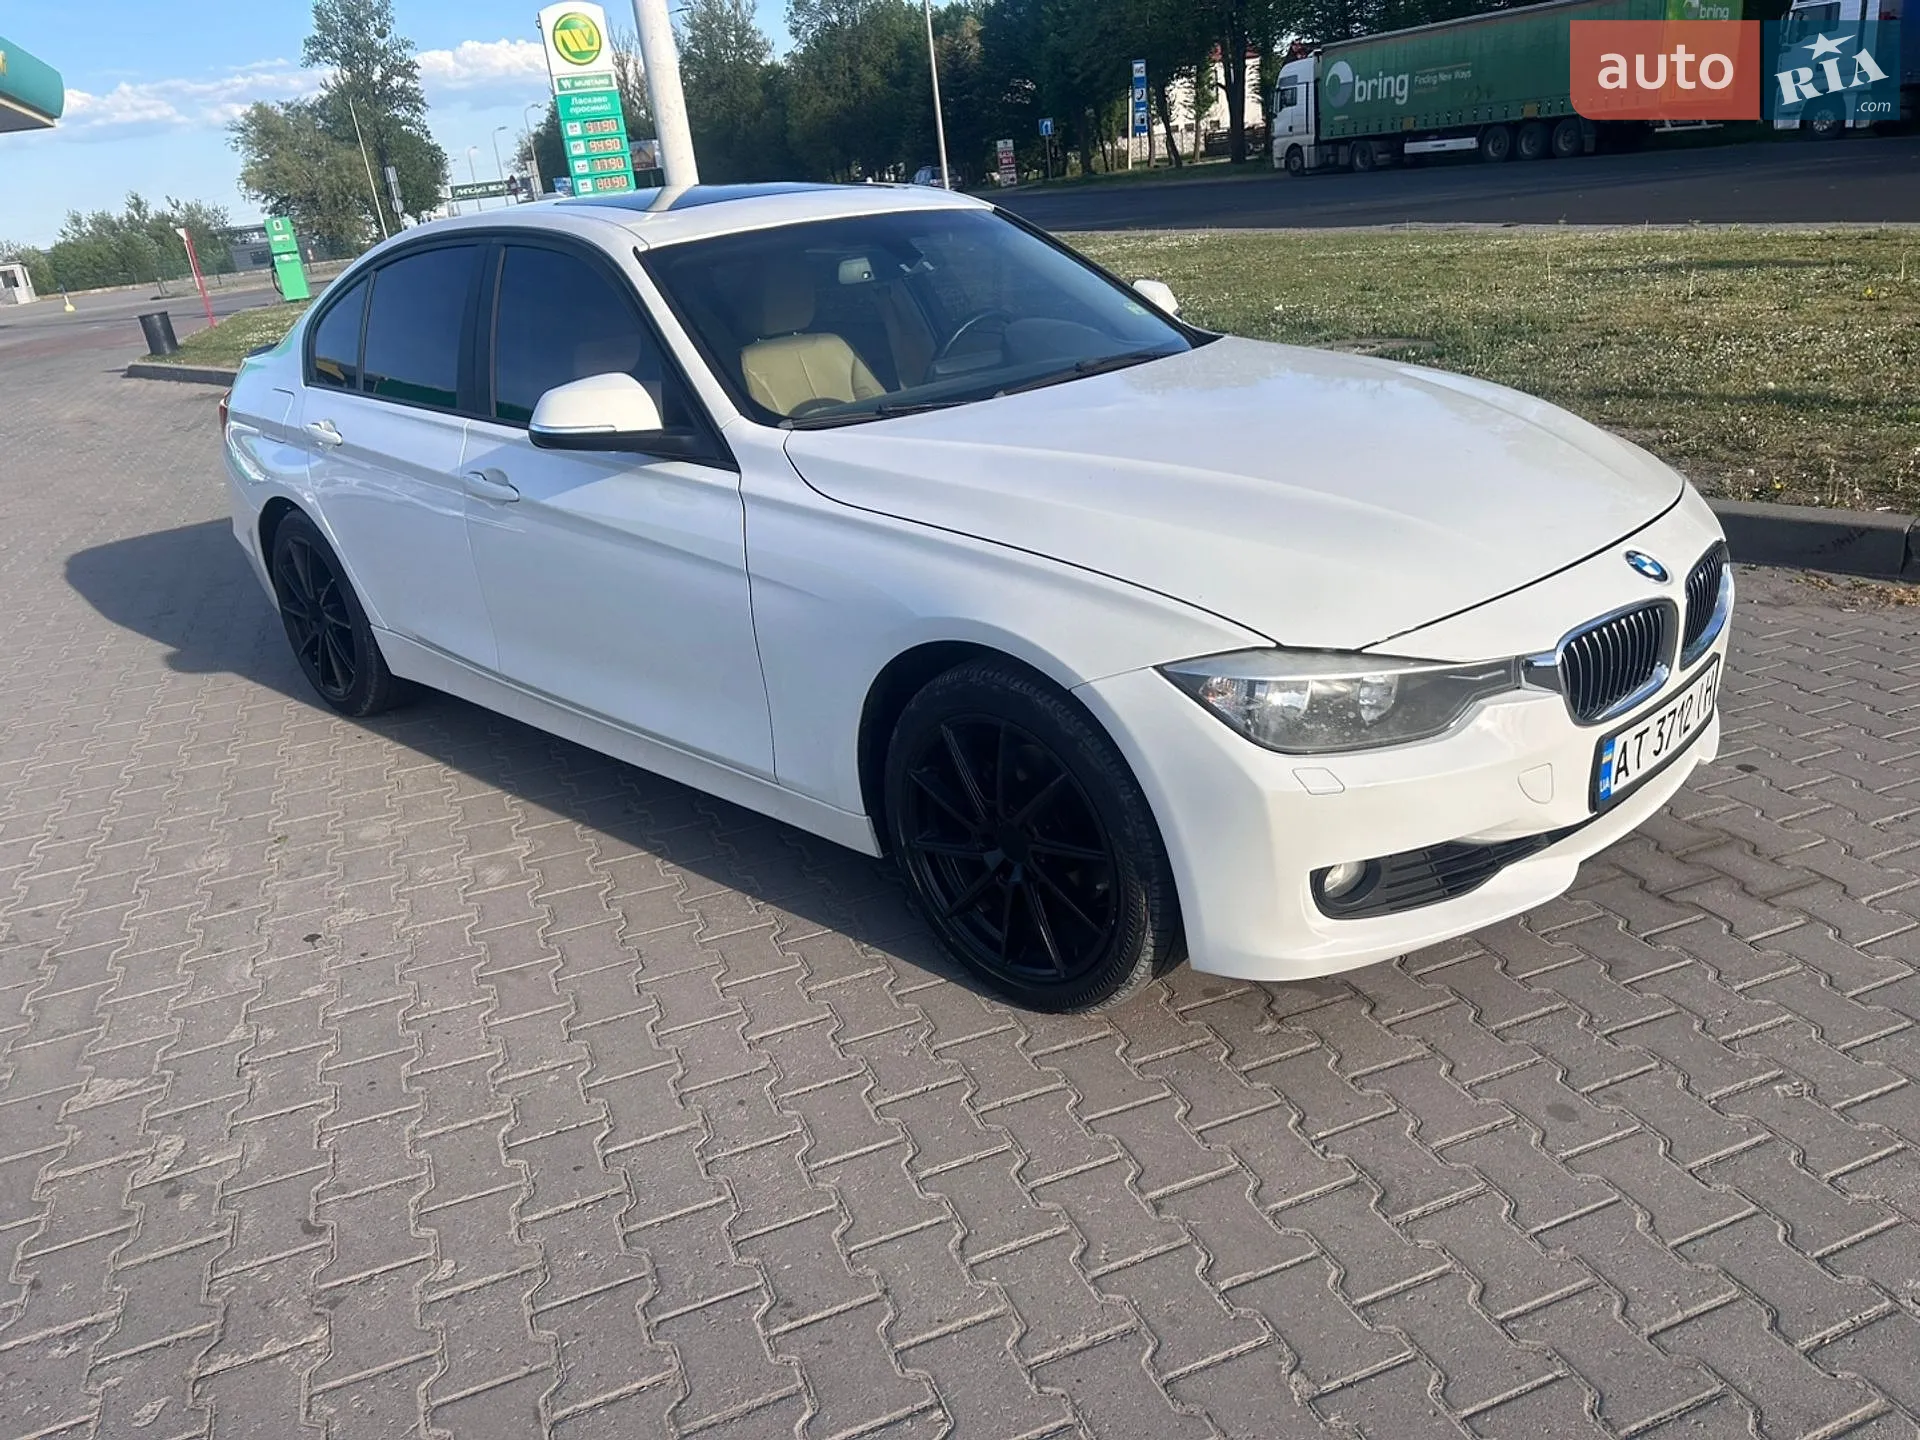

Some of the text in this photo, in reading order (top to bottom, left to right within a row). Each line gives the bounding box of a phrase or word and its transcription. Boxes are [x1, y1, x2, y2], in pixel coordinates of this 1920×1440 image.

[1699, 4, 1729, 22] bring
[1354, 71, 1409, 105] bring
[1614, 727, 1650, 785] AT
[1653, 694, 1693, 757] 3712
